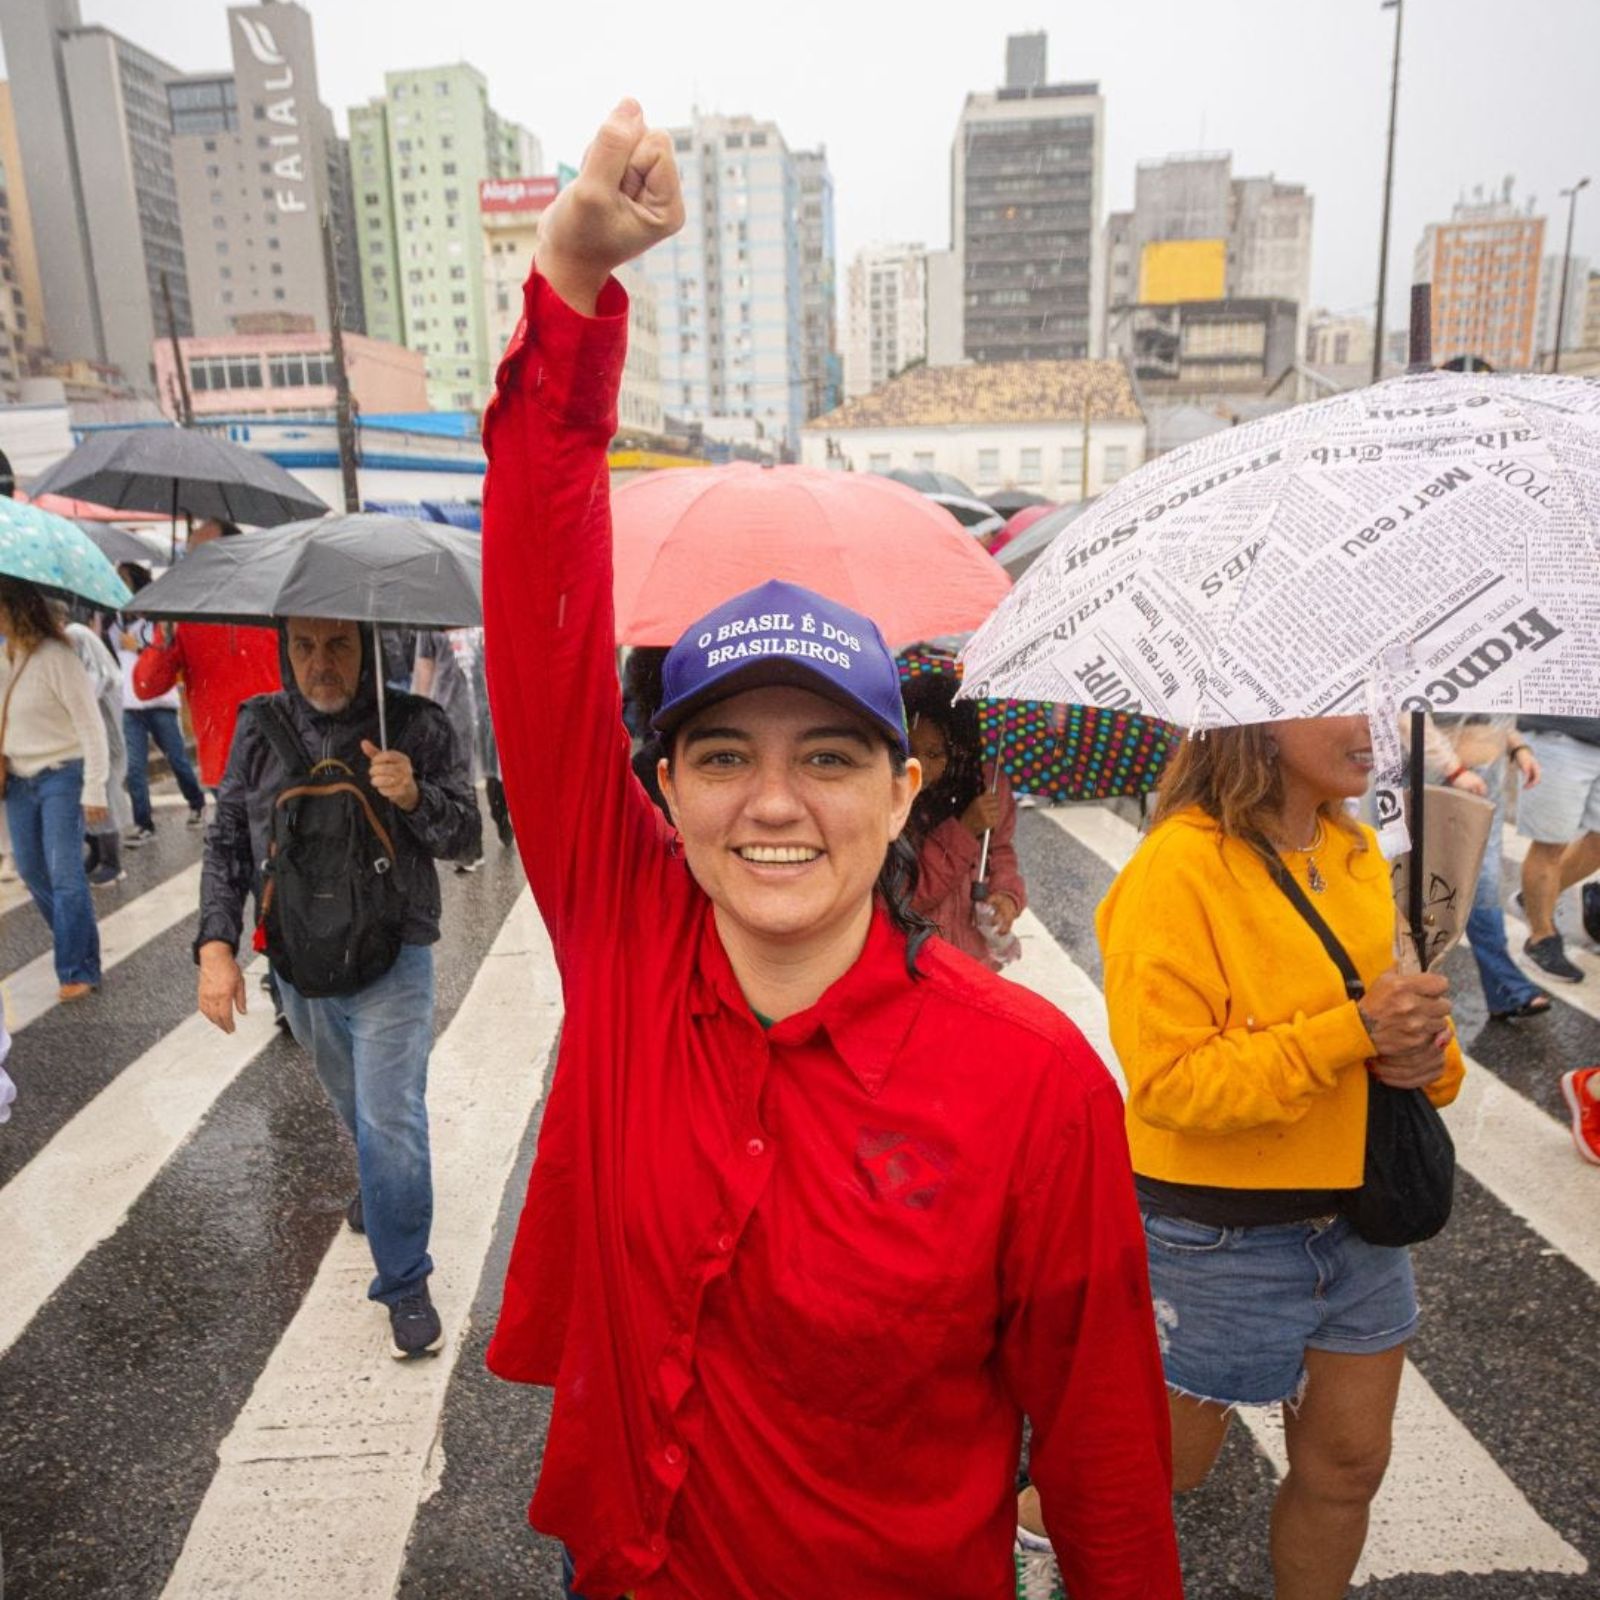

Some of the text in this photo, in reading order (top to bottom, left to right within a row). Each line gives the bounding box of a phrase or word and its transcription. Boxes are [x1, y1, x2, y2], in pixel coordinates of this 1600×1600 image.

[264, 65, 307, 213] FAIAL
[1304, 441, 1383, 465] Trib
[1340, 466, 1473, 558] Marreau
[698, 612, 861, 652] O BRASIL É DOS
[707, 638, 851, 670] BRASILEIROS
[1401, 607, 1564, 713] France
[1205, 669, 1232, 698] PEOP
